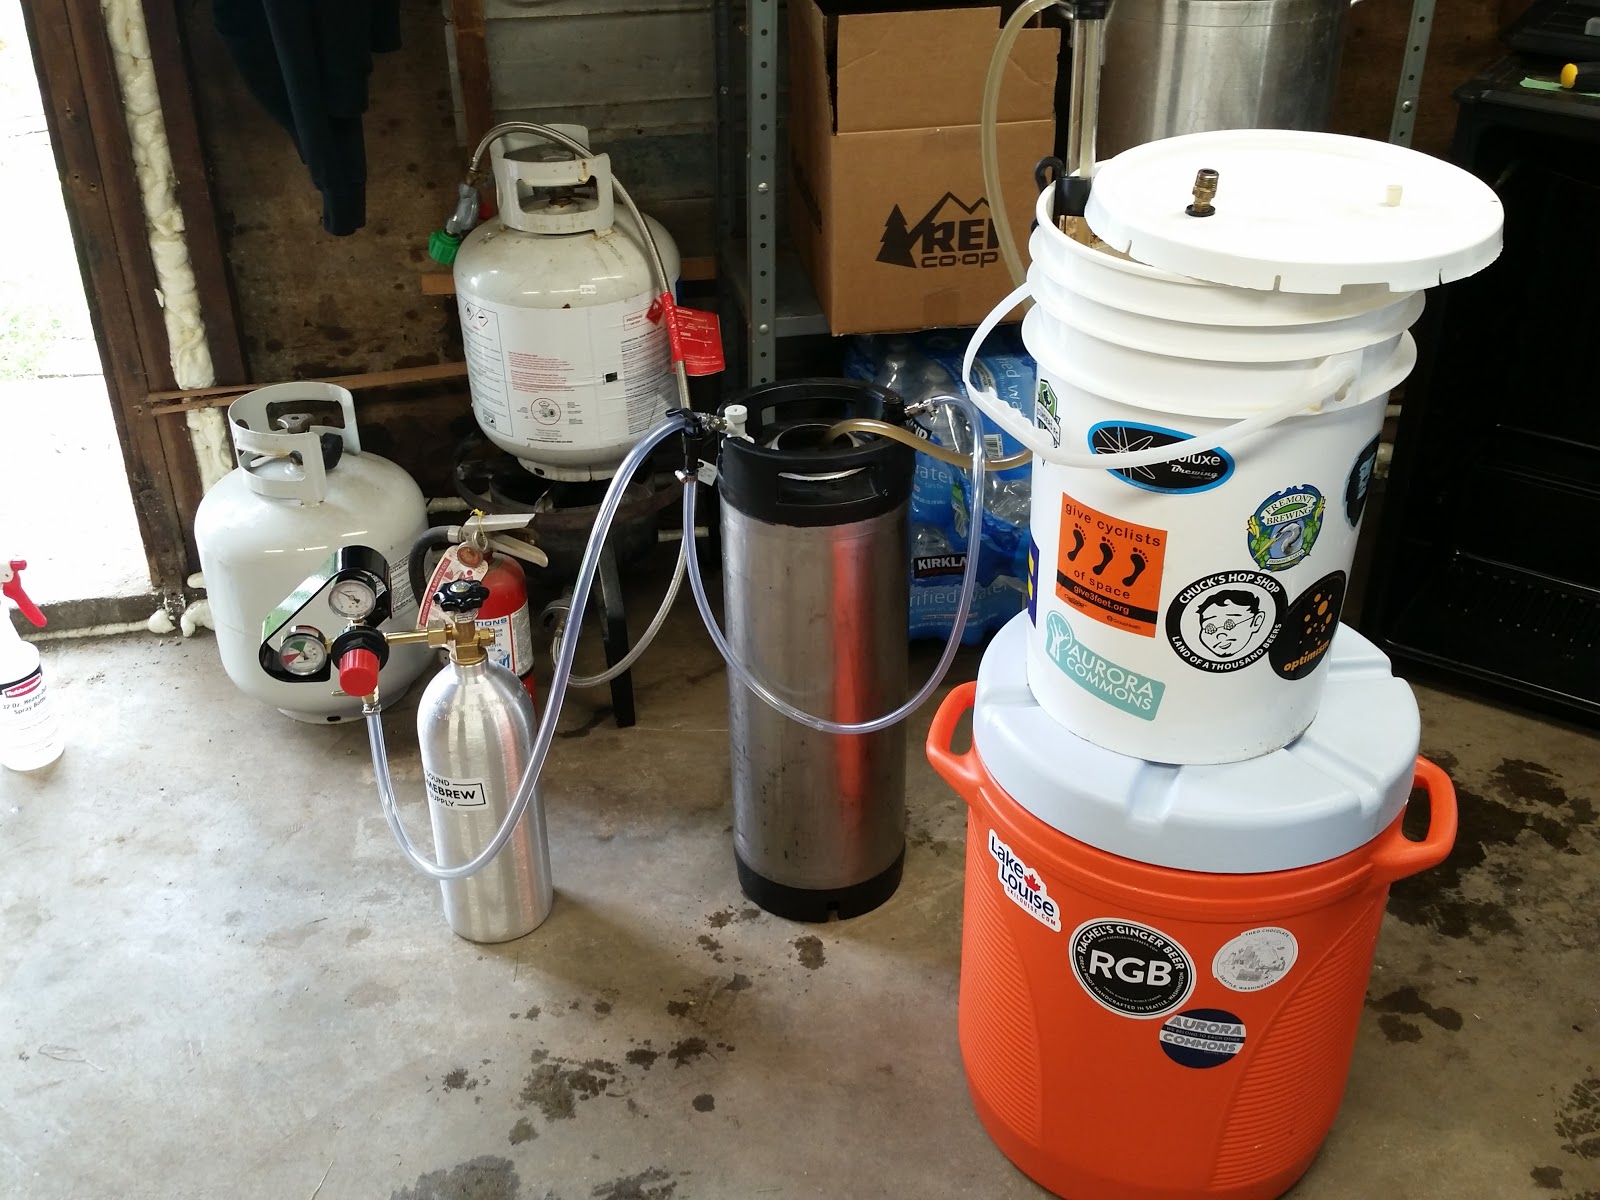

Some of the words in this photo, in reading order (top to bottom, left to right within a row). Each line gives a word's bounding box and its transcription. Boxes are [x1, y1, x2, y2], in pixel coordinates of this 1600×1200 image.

[1170, 463, 1218, 479] Brewing
[1265, 494, 1314, 515] FREMONT
[1266, 505, 1315, 525] BREWING
[1065, 503, 1092, 524] give
[1096, 520, 1161, 547] cyclists
[917, 556, 967, 571] KIRKLA
[909, 588, 958, 608] rified
[1073, 570, 1086, 580] of
[1089, 577, 1131, 599] space
[1179, 574, 1226, 604] CHUCK'S
[1228, 573, 1255, 583] HOP
[1255, 575, 1281, 594] SHOP
[1073, 585, 1130, 615] give3feet.org
[474, 618, 508, 627] TIONS
[1171, 635, 1191, 657] LAND
[1189, 655, 1203, 666] OF
[1202, 661, 1210, 669] A
[1211, 649, 1264, 671] THOUSAND
[1262, 622, 1282, 650] BEERS
[1283, 639, 1330, 672] optimism
[1066, 657, 1152, 710] COMMONS
[1068, 644, 1154, 699] AURORA
[426, 779, 476, 799] MEBREW
[991, 835, 1024, 879] Lake
[1001, 863, 1055, 917] Louise
[1006, 886, 1056, 926] SKILOUISE.COM
[1077, 925, 1114, 955] RACHEL'S
[1116, 925, 1165, 948] GINGER
[1162, 947, 1185, 970] BEER
[1262, 928, 1289, 938] CHOCOLATE
[1089, 949, 1173, 987] RGB
[1094, 986, 1136, 1010] HANDCRAFTED
[1168, 972, 1185, 1001] WASHINGTON
[1239, 979, 1275, 990] WASHINGTON
[1169, 1016, 1242, 1035] AURORA
[1163, 1033, 1237, 1052] COMMONS
